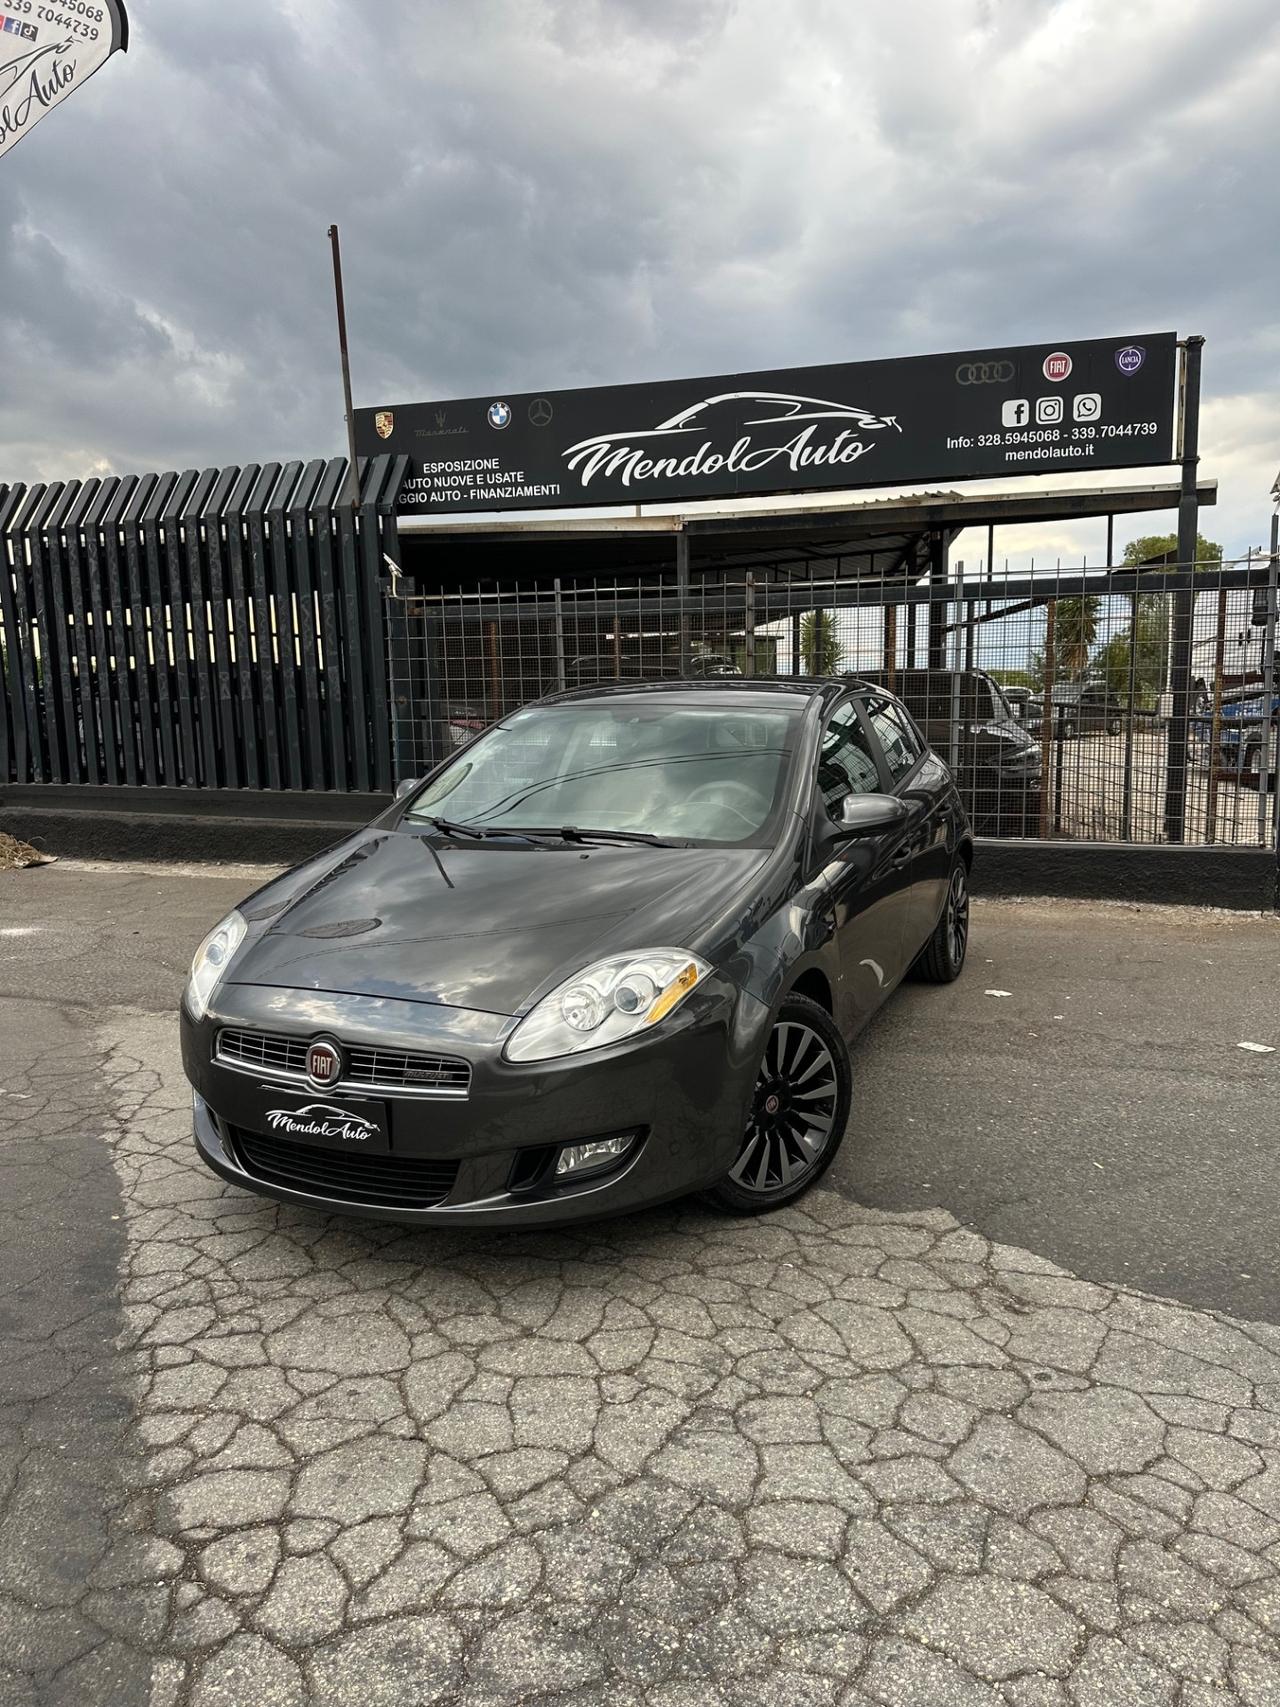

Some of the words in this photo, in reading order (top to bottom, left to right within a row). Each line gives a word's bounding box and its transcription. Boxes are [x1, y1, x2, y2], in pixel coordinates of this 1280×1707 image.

[50, 0, 103, 22] 45068
[37, 5, 99, 41] 7044739
[1049, 360, 1067, 374] FIAT
[1121, 355, 1139, 364] LANCIA
[946, 437, 974, 449] Info:
[977, 429, 1060, 447] 328.5945068
[1071, 422, 1158, 440] 339.7044739
[1005, 443, 1095, 461] mendolauto.it
[423, 458, 500, 474] ESPOSIZIONE
[433, 474, 474, 488] NUOVE
[476, 474, 484, 485] E
[486, 471, 525, 485] USATE
[397, 492, 428, 504] GGIO
[430, 490, 461, 503] AUTO
[470, 484, 560, 500] FINANZIAMENTI
[312, 1054, 333, 1076] FIAT
